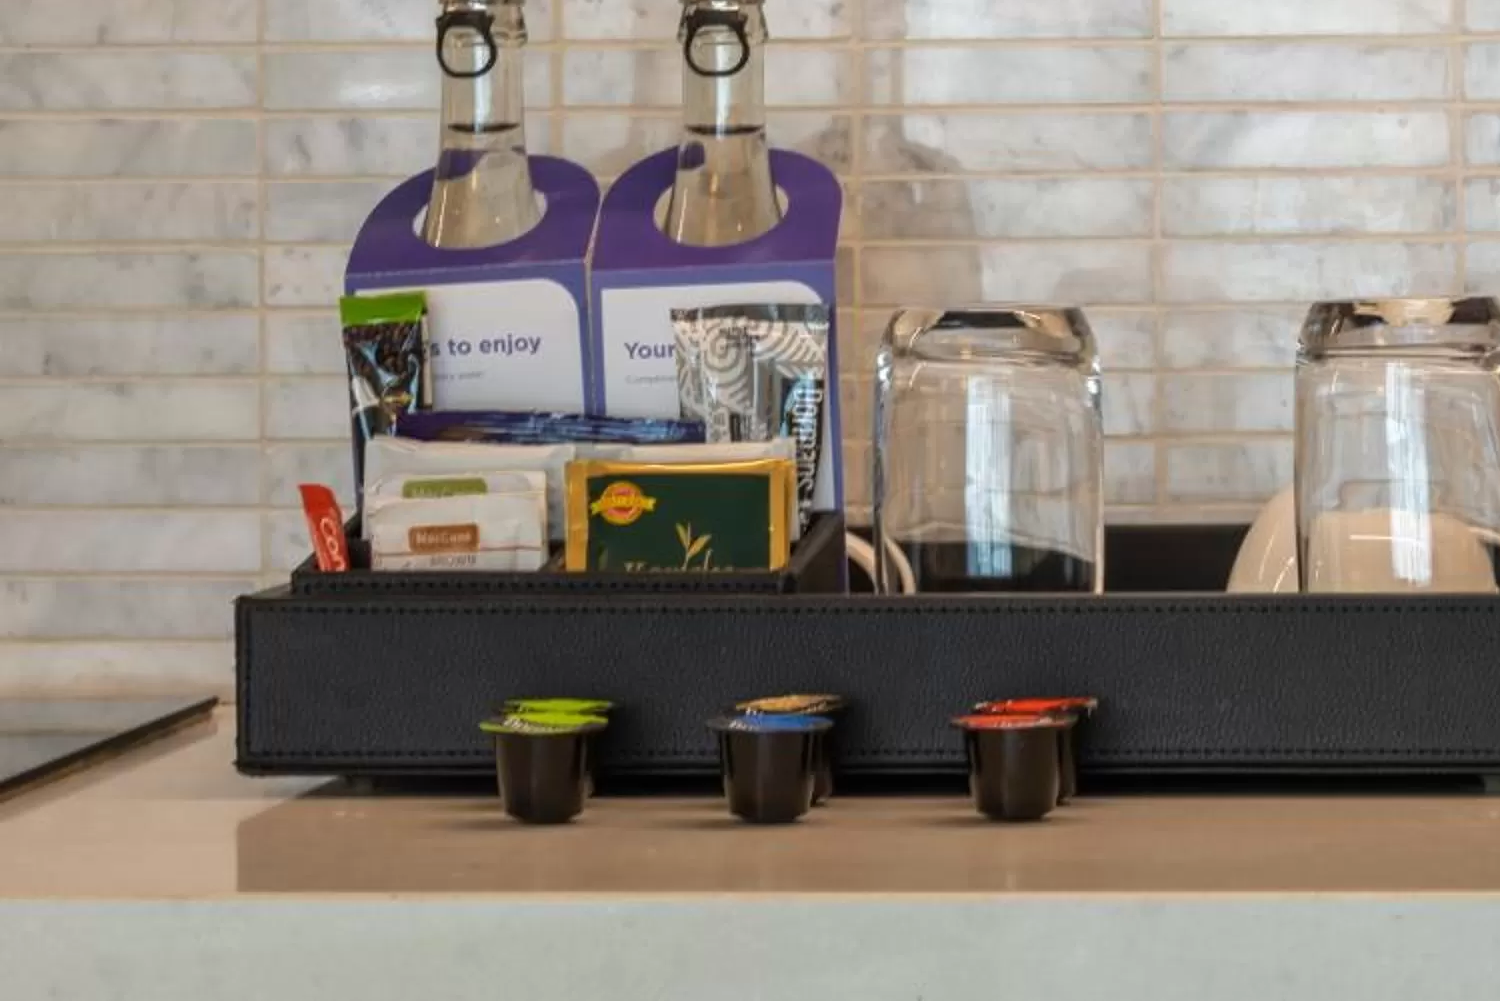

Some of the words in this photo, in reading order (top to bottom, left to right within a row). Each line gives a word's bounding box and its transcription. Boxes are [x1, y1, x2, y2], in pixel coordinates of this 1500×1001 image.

[447, 338, 472, 356] to
[479, 334, 542, 355] enjoy
[623, 341, 676, 360] Your
